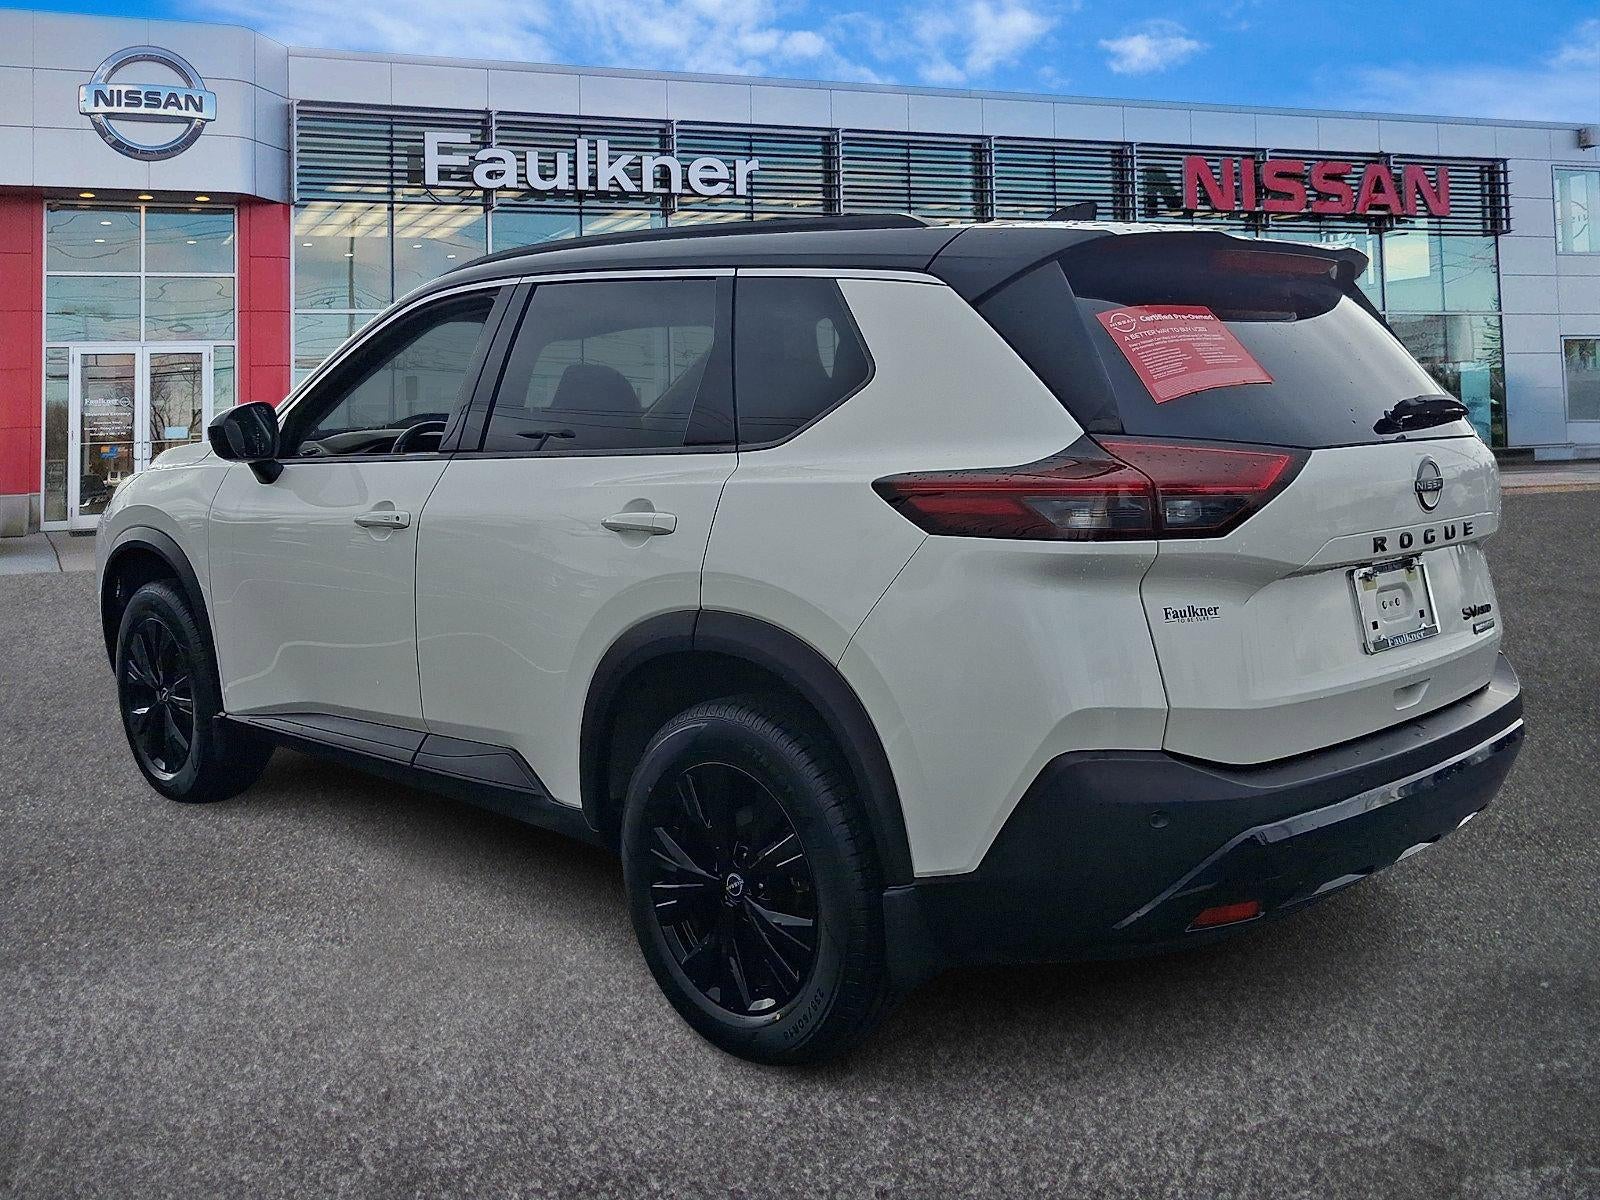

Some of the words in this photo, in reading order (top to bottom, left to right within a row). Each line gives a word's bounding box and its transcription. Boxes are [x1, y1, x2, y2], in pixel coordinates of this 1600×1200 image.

[93, 89, 203, 113] NISSAN
[423, 130, 760, 197] Faulkner
[1182, 155, 1450, 216] NISSAN
[1110, 317, 1137, 328] NISSAN
[1140, 313, 1174, 322] Certified
[1175, 313, 1214, 321] Pre-Owned
[1131, 328, 1158, 340] BETTER
[1372, 521, 1474, 553] ROGUE
[1163, 605, 1219, 620] Faulkner
[1387, 630, 1425, 646] Faulkner
